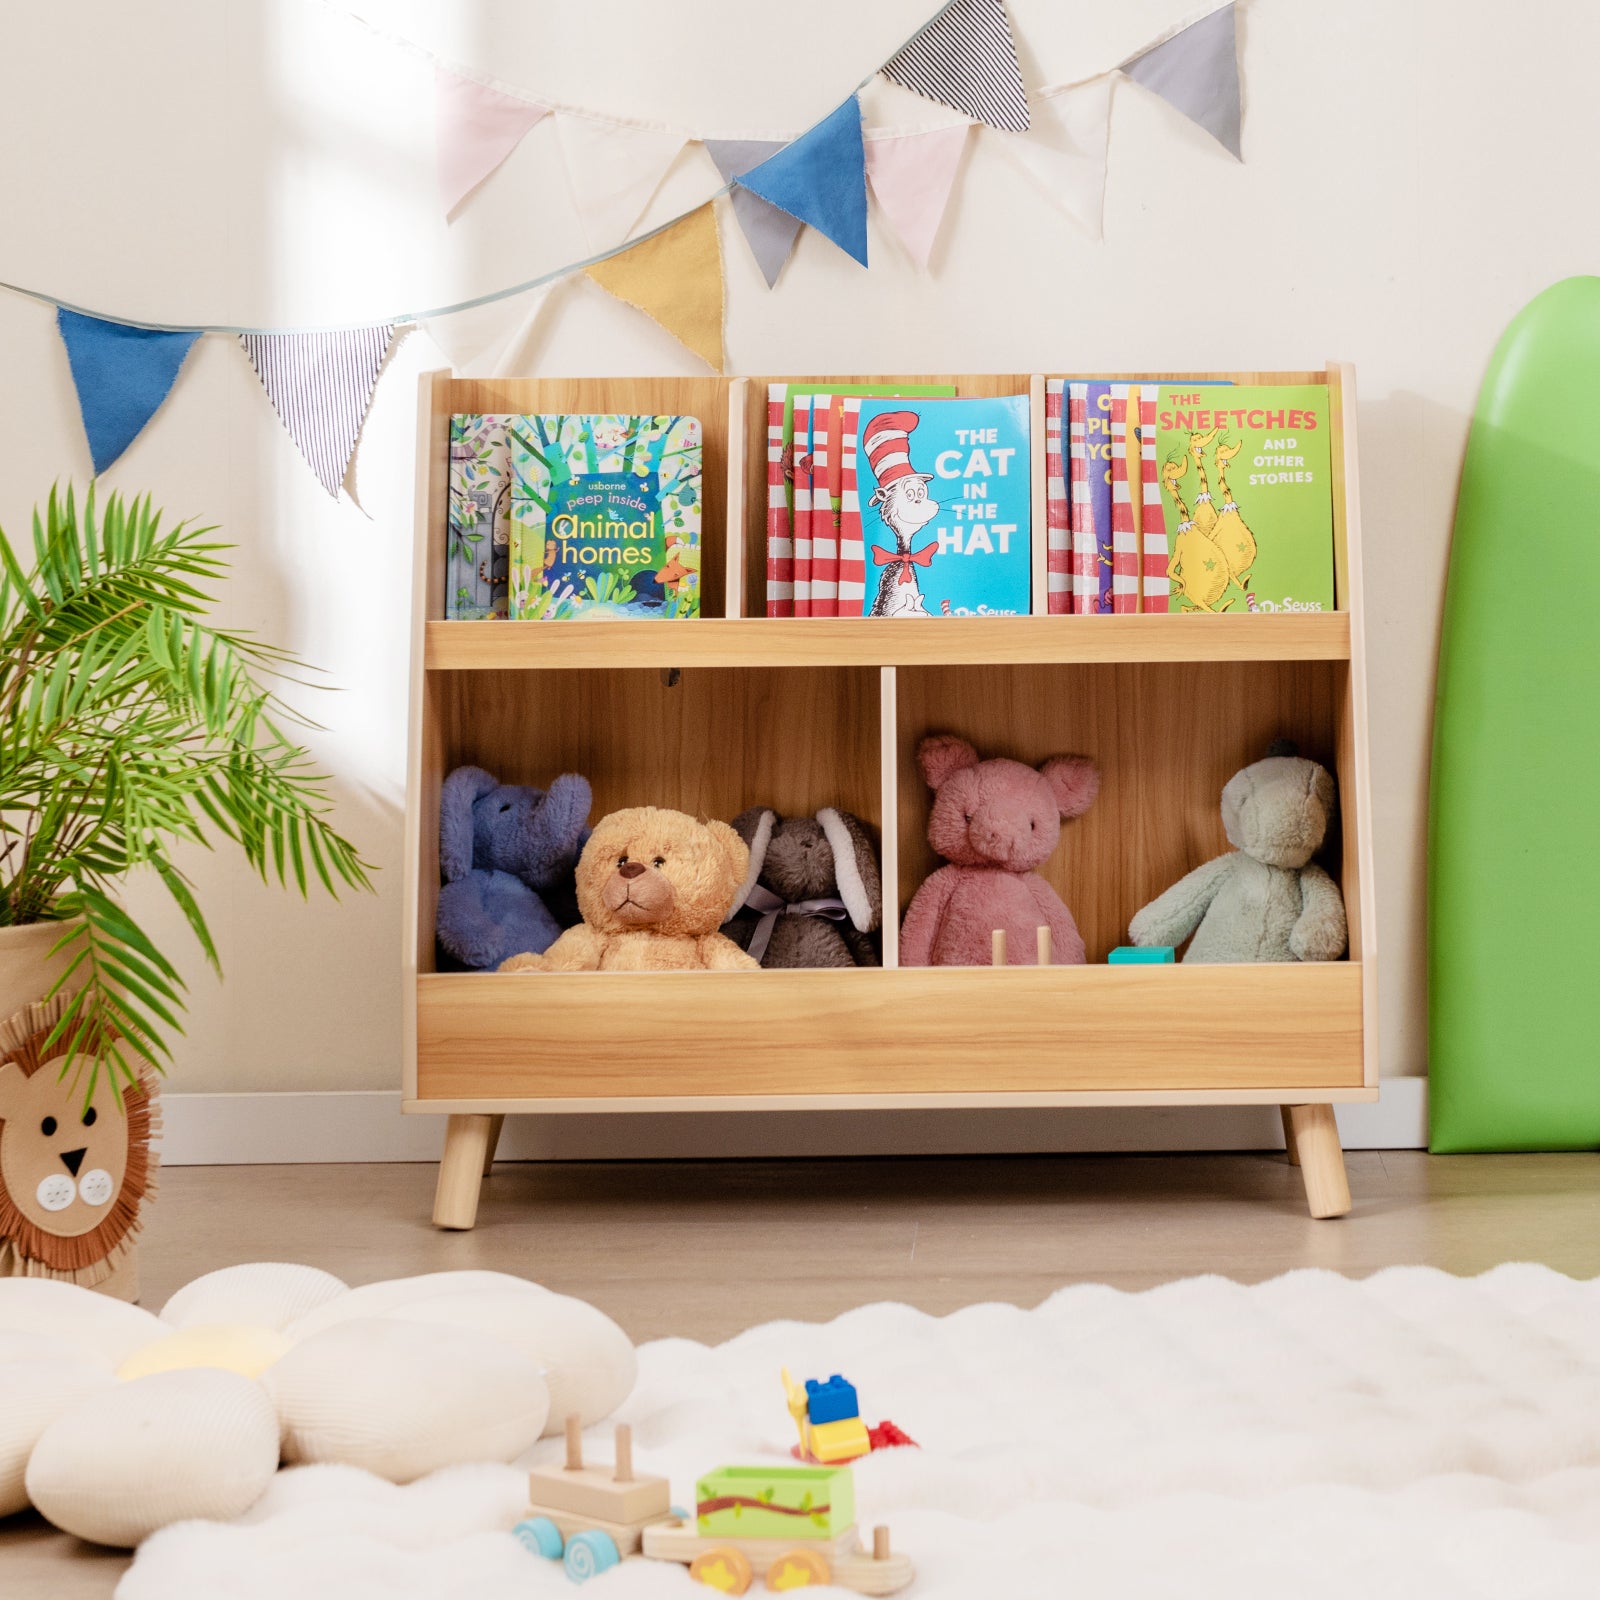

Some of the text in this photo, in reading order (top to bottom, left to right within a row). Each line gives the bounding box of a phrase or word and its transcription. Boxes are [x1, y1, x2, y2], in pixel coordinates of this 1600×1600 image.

[1169, 394, 1200, 406] THE
[1159, 409, 1318, 431] SNEETCHES
[955, 428, 998, 445] THE
[1263, 438, 1297, 450] AND
[935, 448, 1016, 479] CAT
[1253, 455, 1304, 467] OTHER
[588, 481, 627, 491] usborne
[1249, 471, 1313, 485] STORIES
[963, 482, 987, 499] IN
[567, 492, 647, 511] peep inside
[952, 503, 998, 520] THE
[552, 511, 655, 540] animal
[937, 523, 1017, 556] HAT
[562, 540, 652, 564] homes
[1282, 597, 1322, 613] Seuss
